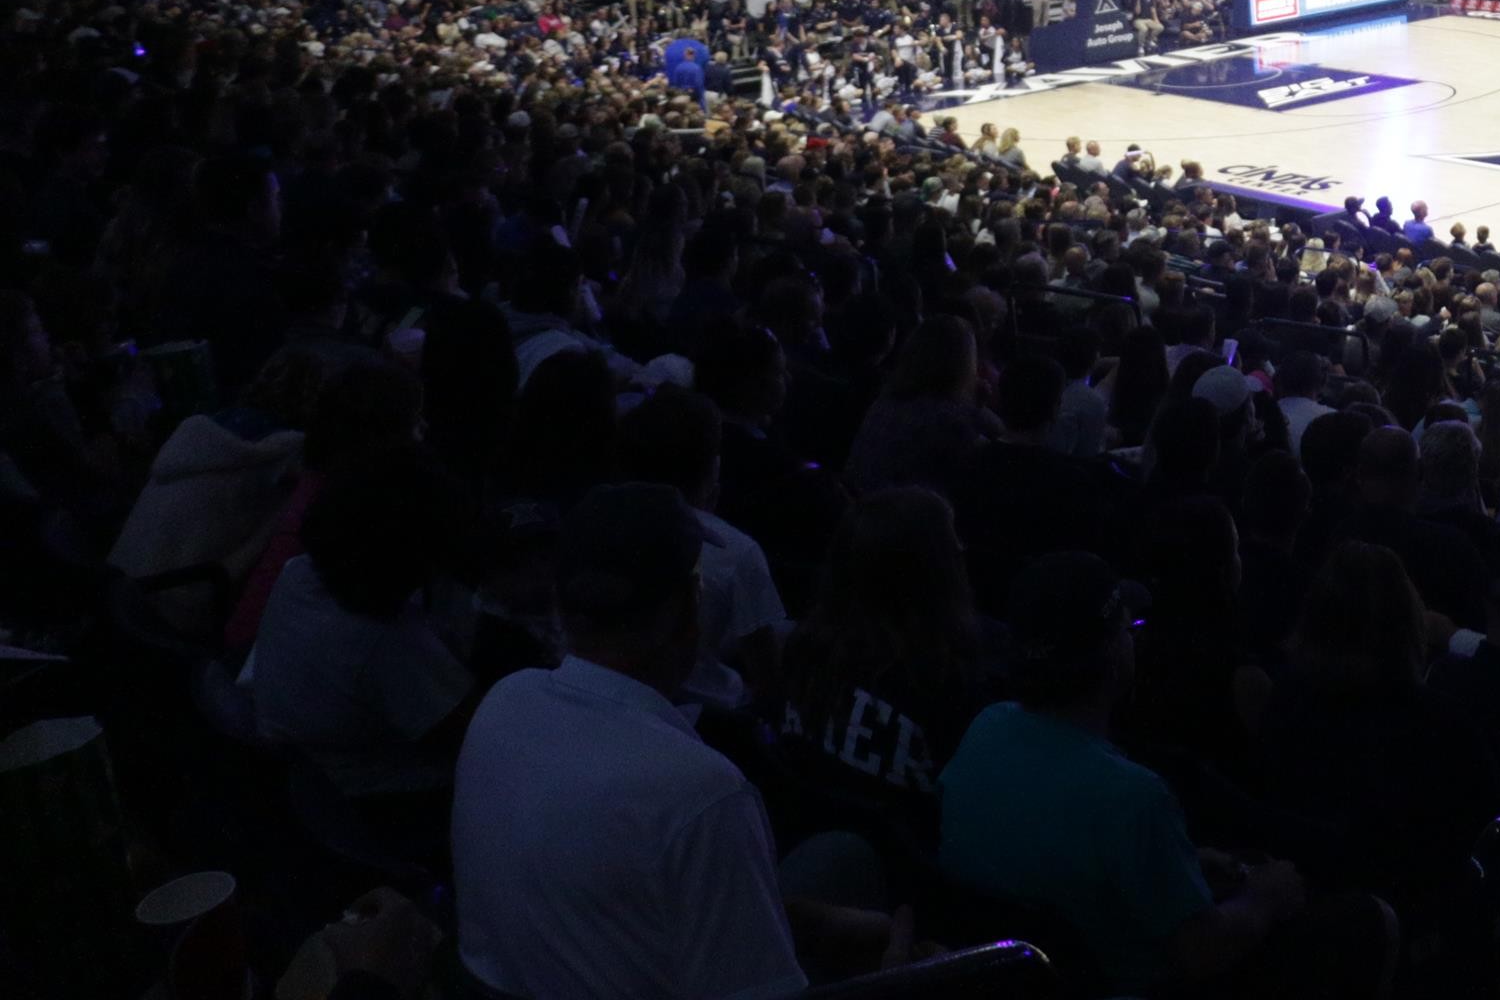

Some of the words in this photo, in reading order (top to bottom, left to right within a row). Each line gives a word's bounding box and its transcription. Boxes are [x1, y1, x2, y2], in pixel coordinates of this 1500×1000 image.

[1094, 20, 1124, 33] Joseph
[1087, 37, 1107, 48] Auto
[1107, 33, 1134, 44] Group
